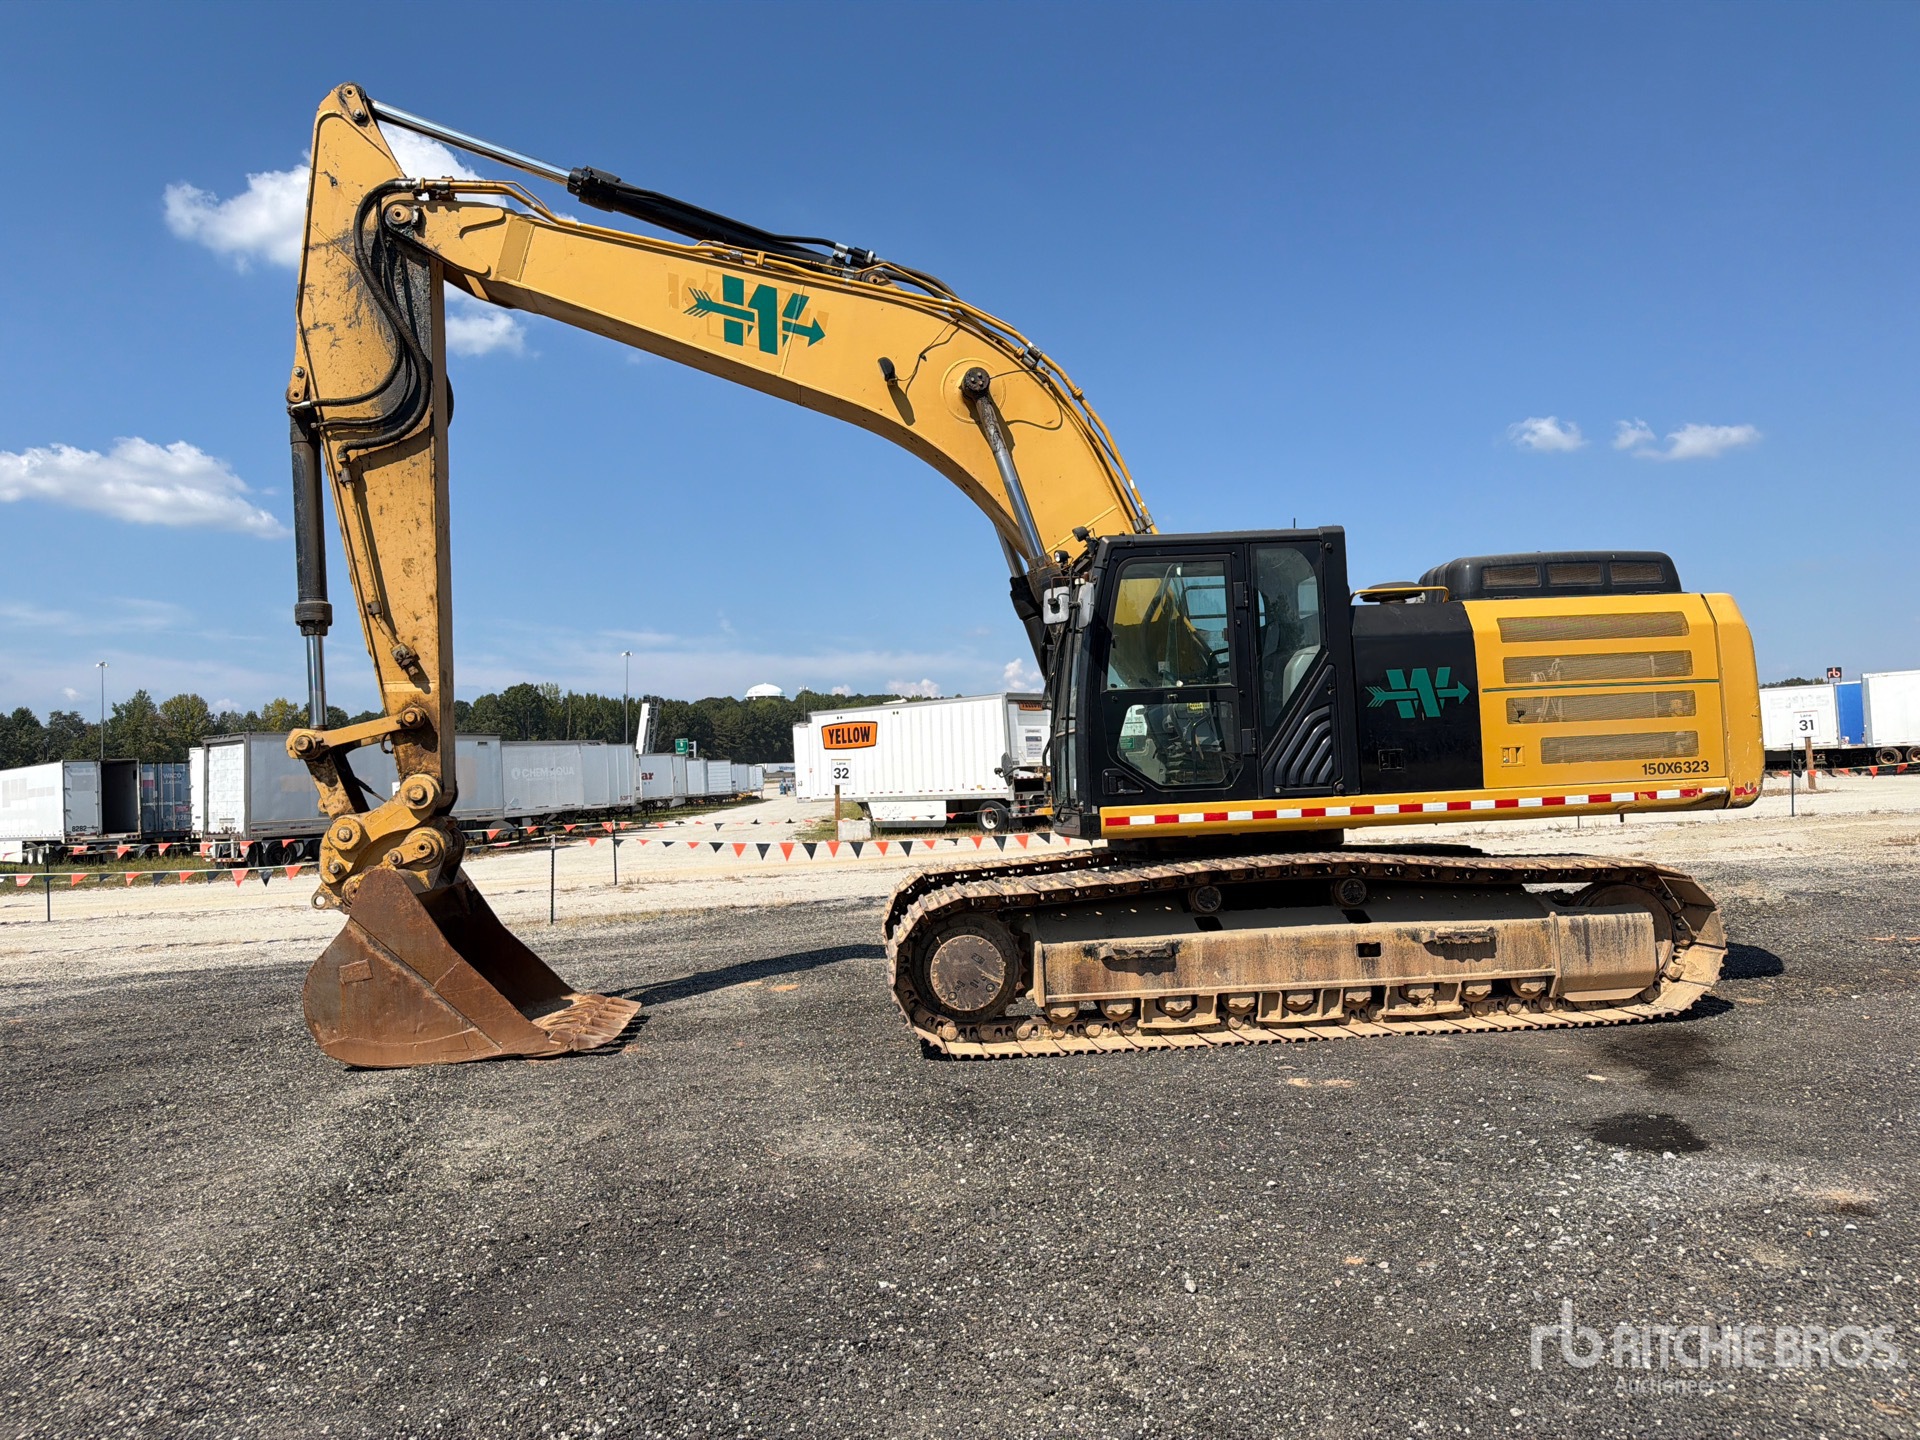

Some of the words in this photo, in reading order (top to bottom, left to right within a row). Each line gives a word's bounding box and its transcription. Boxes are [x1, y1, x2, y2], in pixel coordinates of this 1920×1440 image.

[1799, 719, 1814, 731] 31
[828, 726, 871, 745] YELLOW
[833, 767, 850, 779] 32
[1641, 760, 1710, 776] 150X6323
